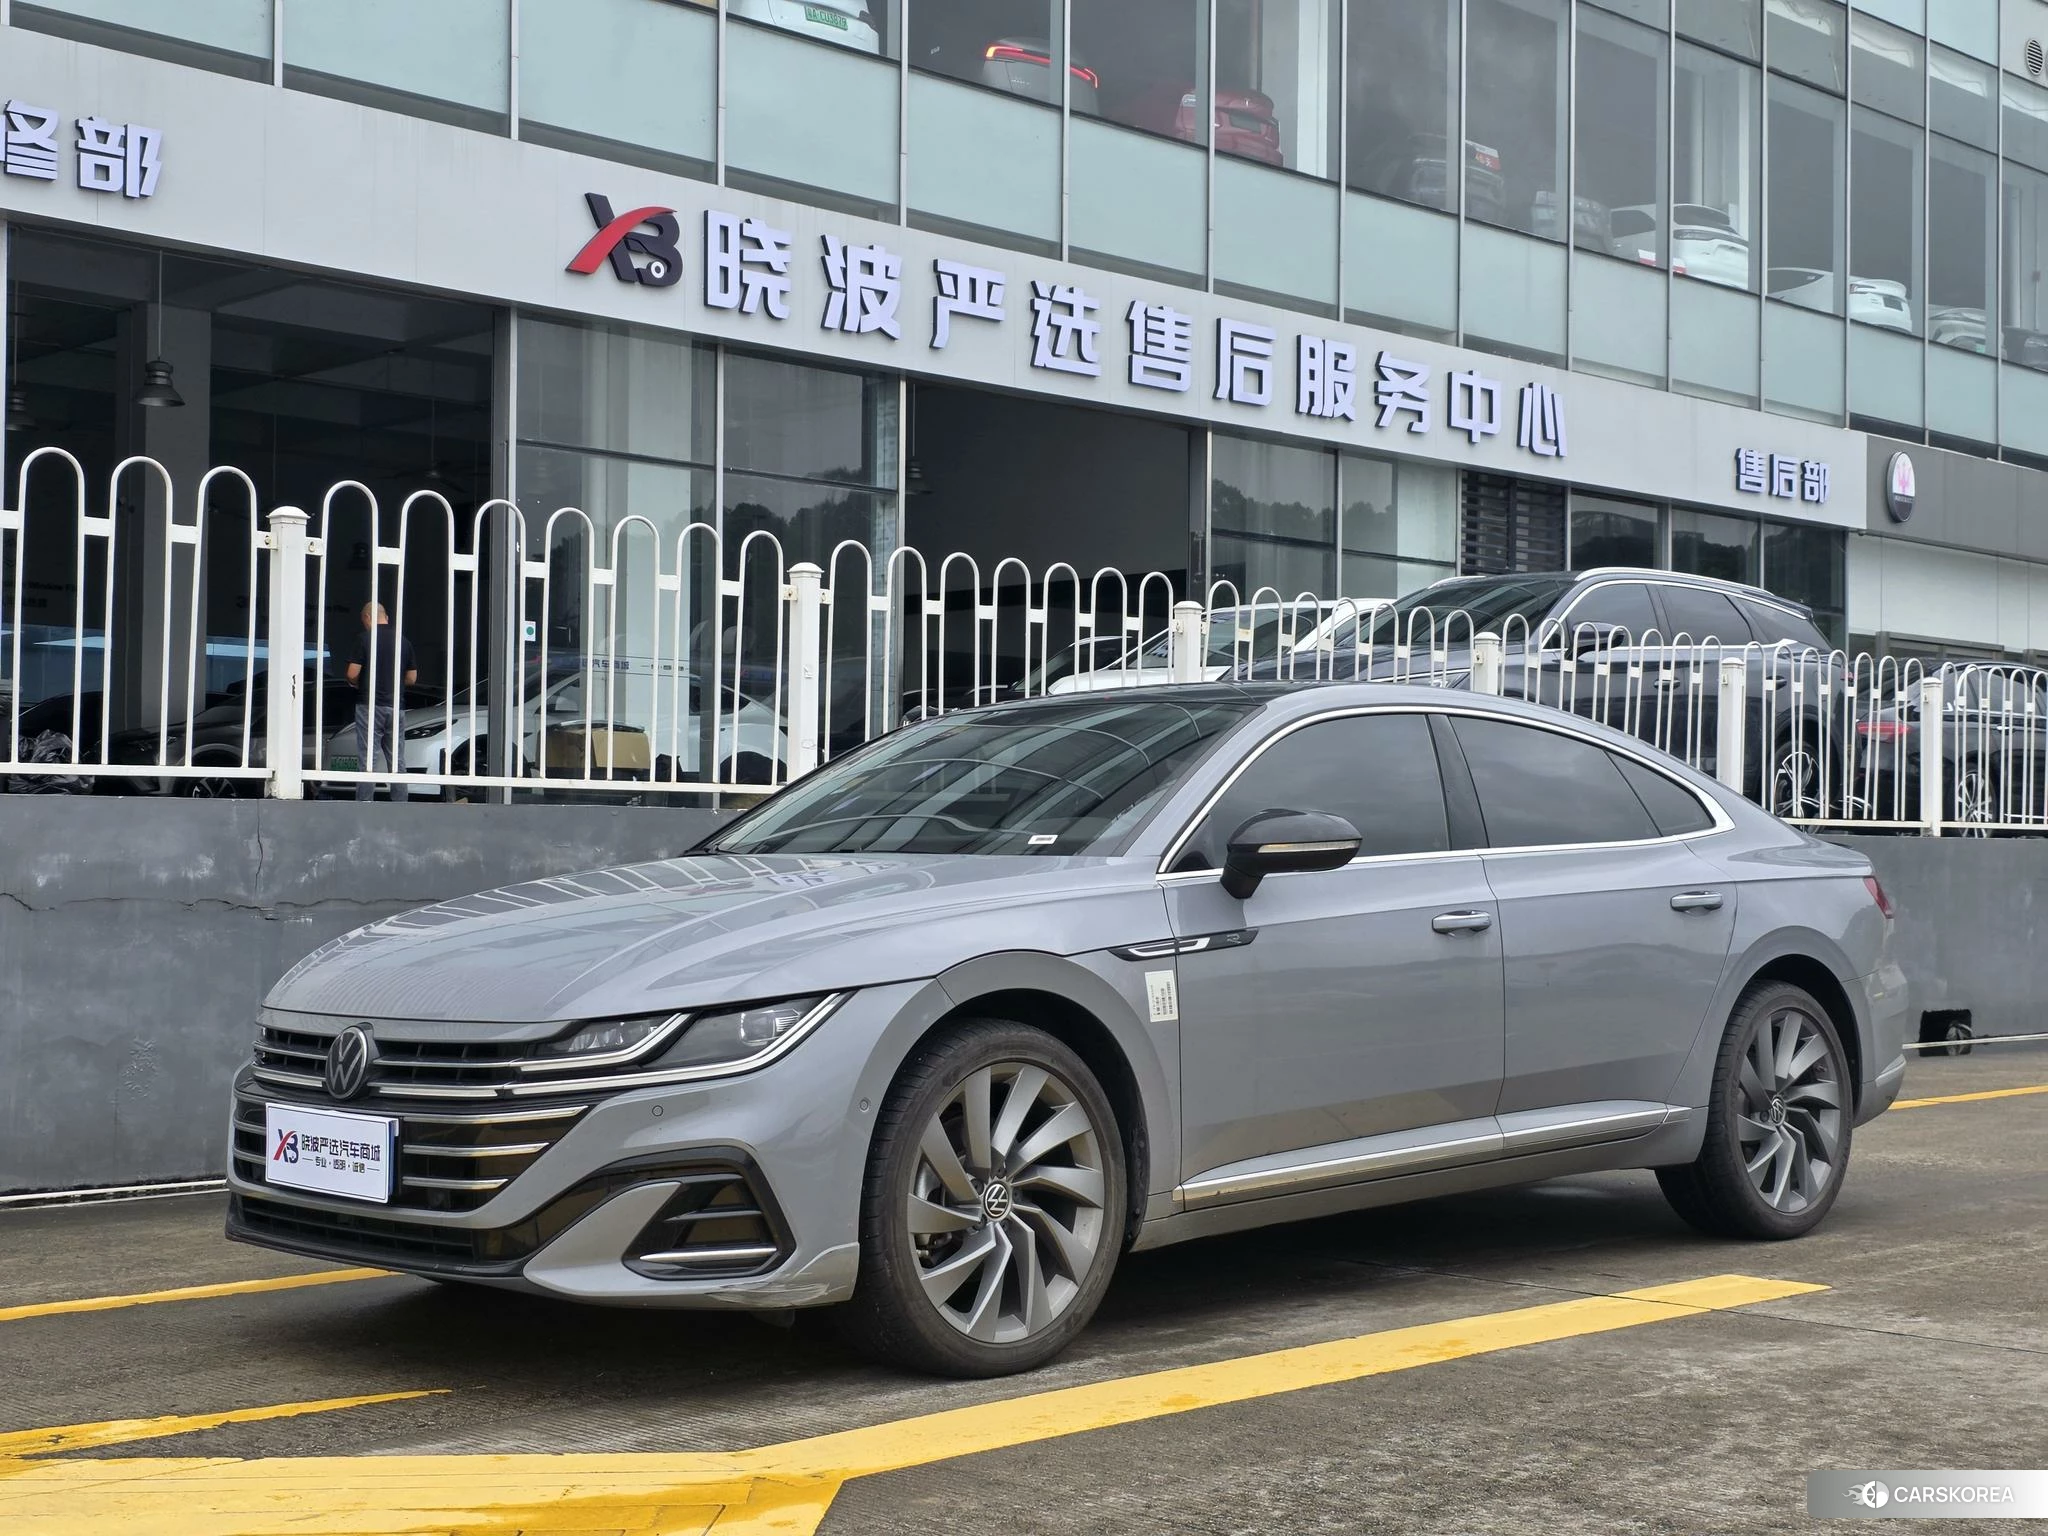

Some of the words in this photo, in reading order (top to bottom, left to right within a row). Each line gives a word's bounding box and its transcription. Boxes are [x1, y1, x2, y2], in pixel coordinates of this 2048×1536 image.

[703, 209, 1567, 457] 晓波严选售后服务中心
[1735, 447, 1831, 503] 售后部
[301, 1134, 381, 1161] 晓波严选汽车商城
